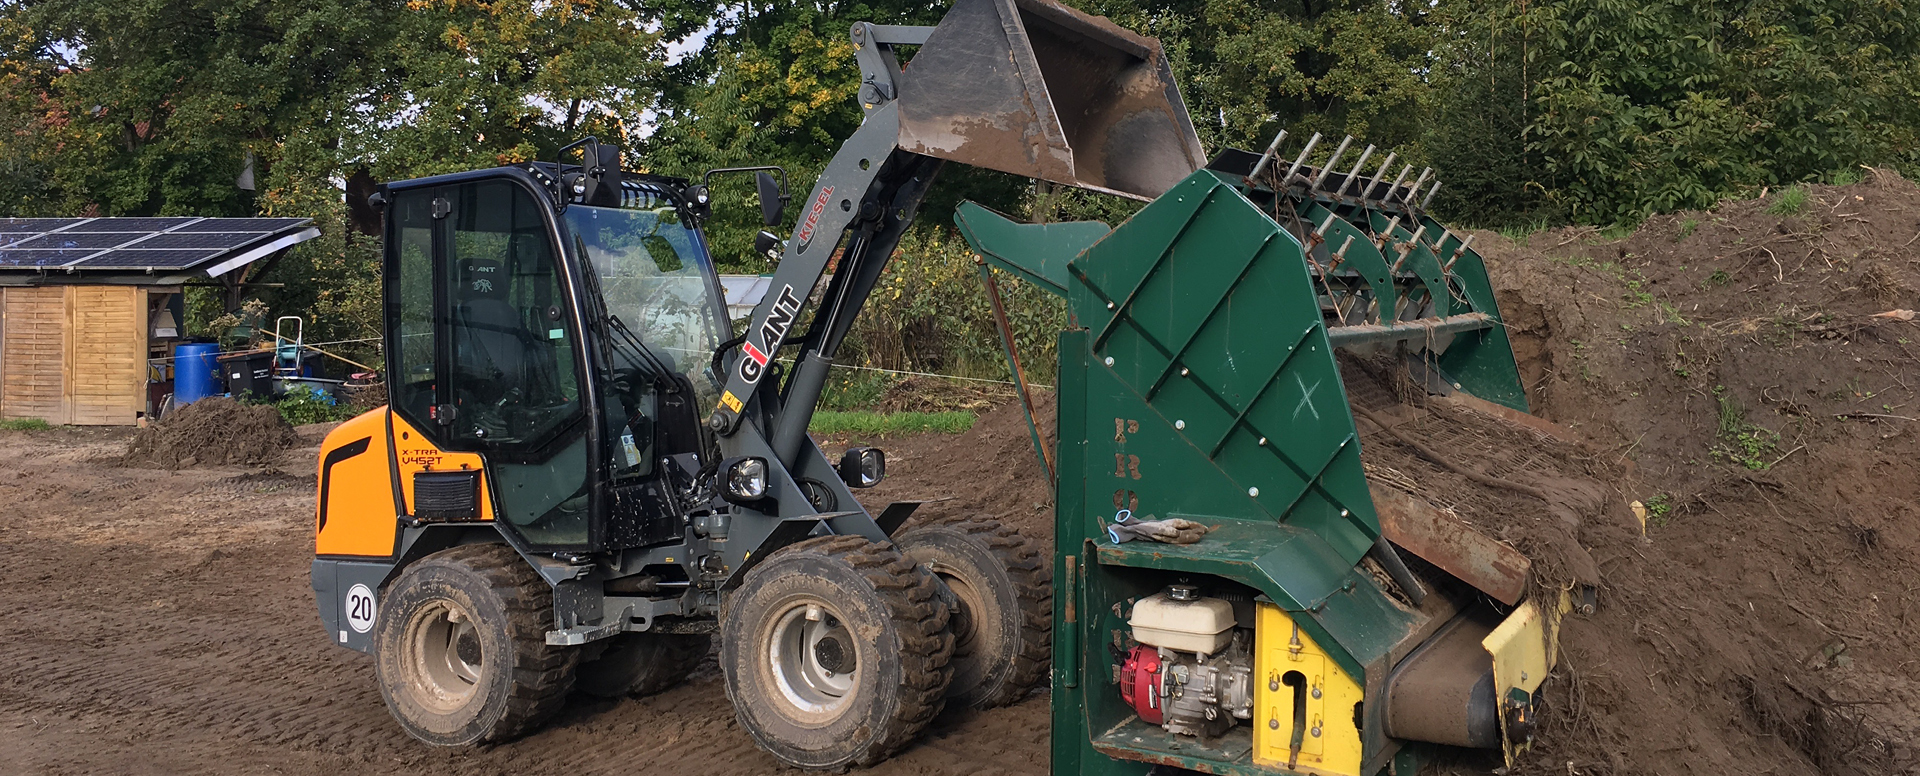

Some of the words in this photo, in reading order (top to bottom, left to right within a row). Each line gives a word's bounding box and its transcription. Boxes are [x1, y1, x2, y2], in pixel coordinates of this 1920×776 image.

[799, 185, 835, 242] KIESEL
[402, 456, 443, 465] V452T
[350, 594, 372, 622] 20
